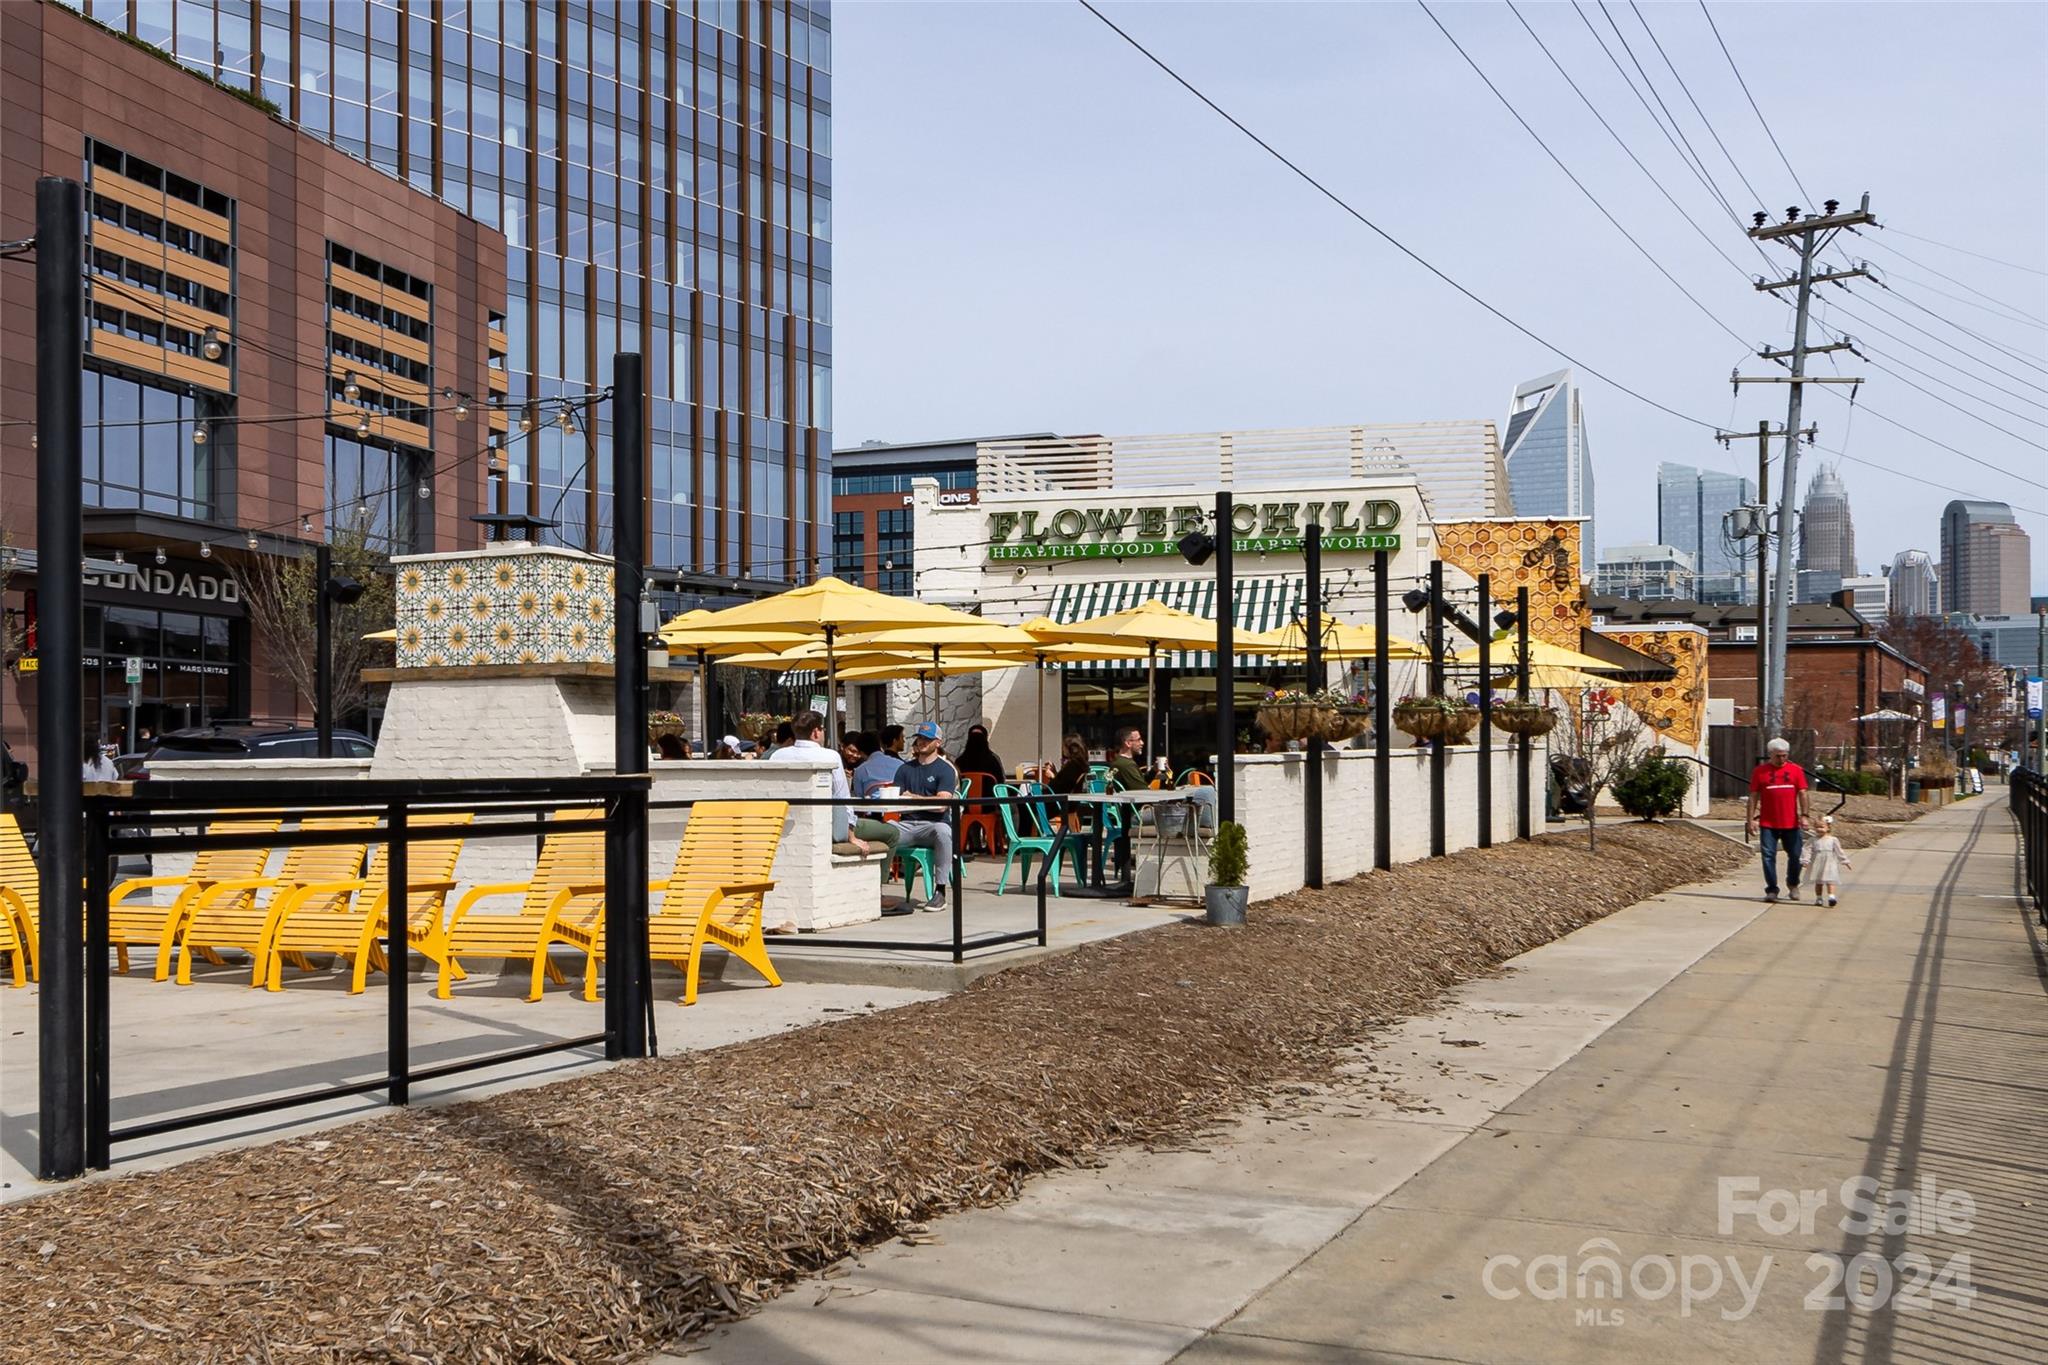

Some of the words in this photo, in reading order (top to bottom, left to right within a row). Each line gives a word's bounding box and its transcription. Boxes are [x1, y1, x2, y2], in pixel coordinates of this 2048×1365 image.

[903, 493, 971, 505] PONS
[990, 506, 1208, 541] FLOWER
[1231, 500, 1401, 533] CHILD
[993, 545, 1089, 559] HEALTHY
[1100, 542, 1154, 555] FOOD
[1320, 536, 1397, 549] WORLD
[121, 660, 158, 670] TILA
